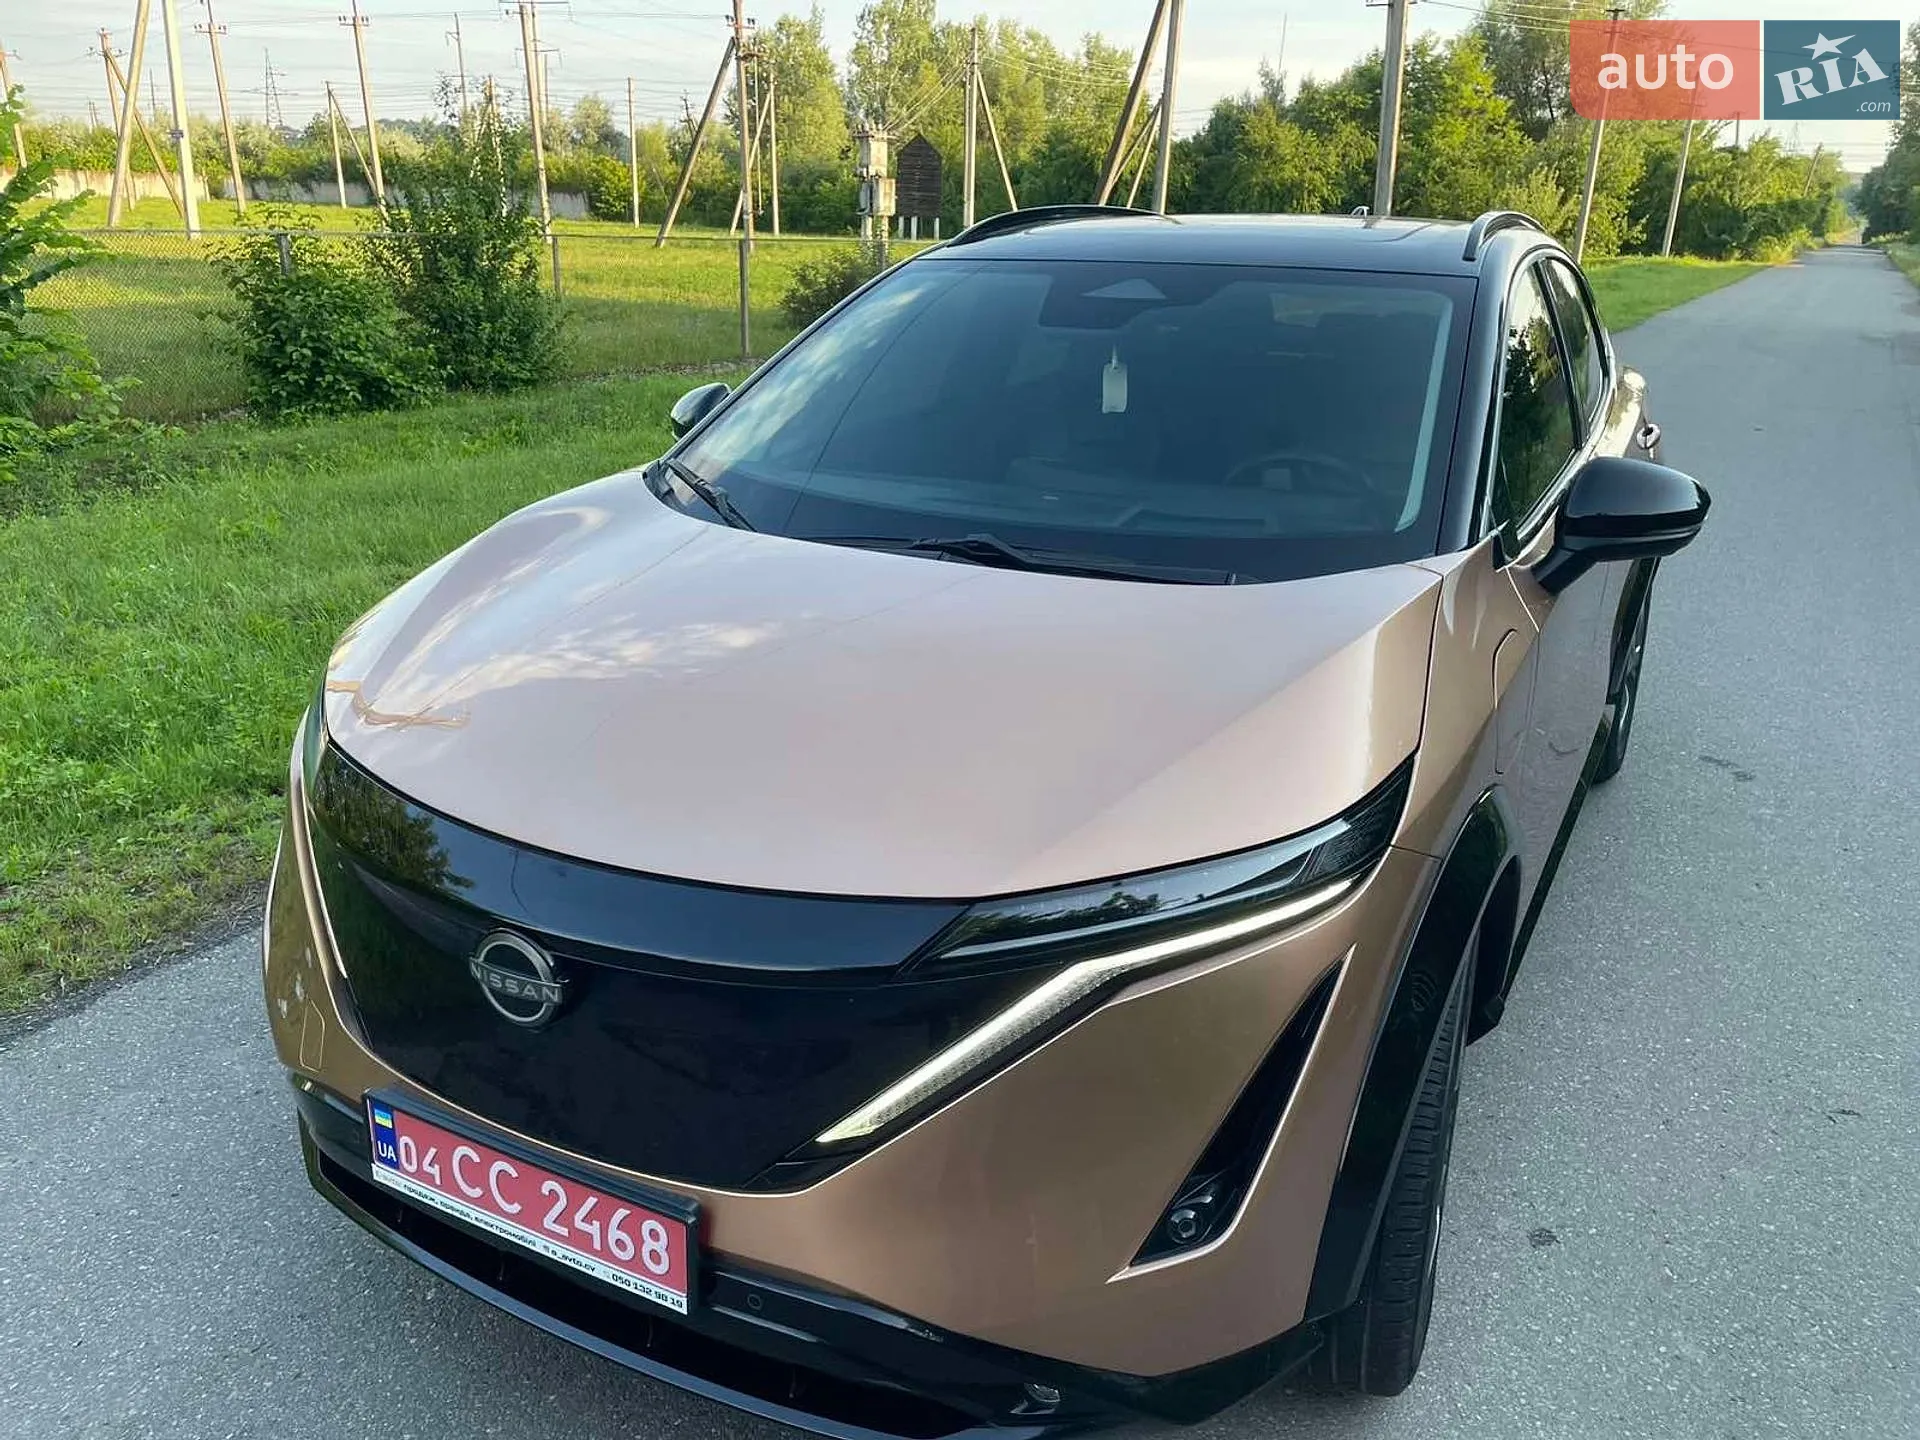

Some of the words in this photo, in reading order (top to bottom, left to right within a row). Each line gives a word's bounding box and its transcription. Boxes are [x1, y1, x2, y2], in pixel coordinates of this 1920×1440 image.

[470, 960, 560, 1003] NISSAN
[377, 1140, 397, 1163] UA
[541, 1181, 670, 1275] 2468
